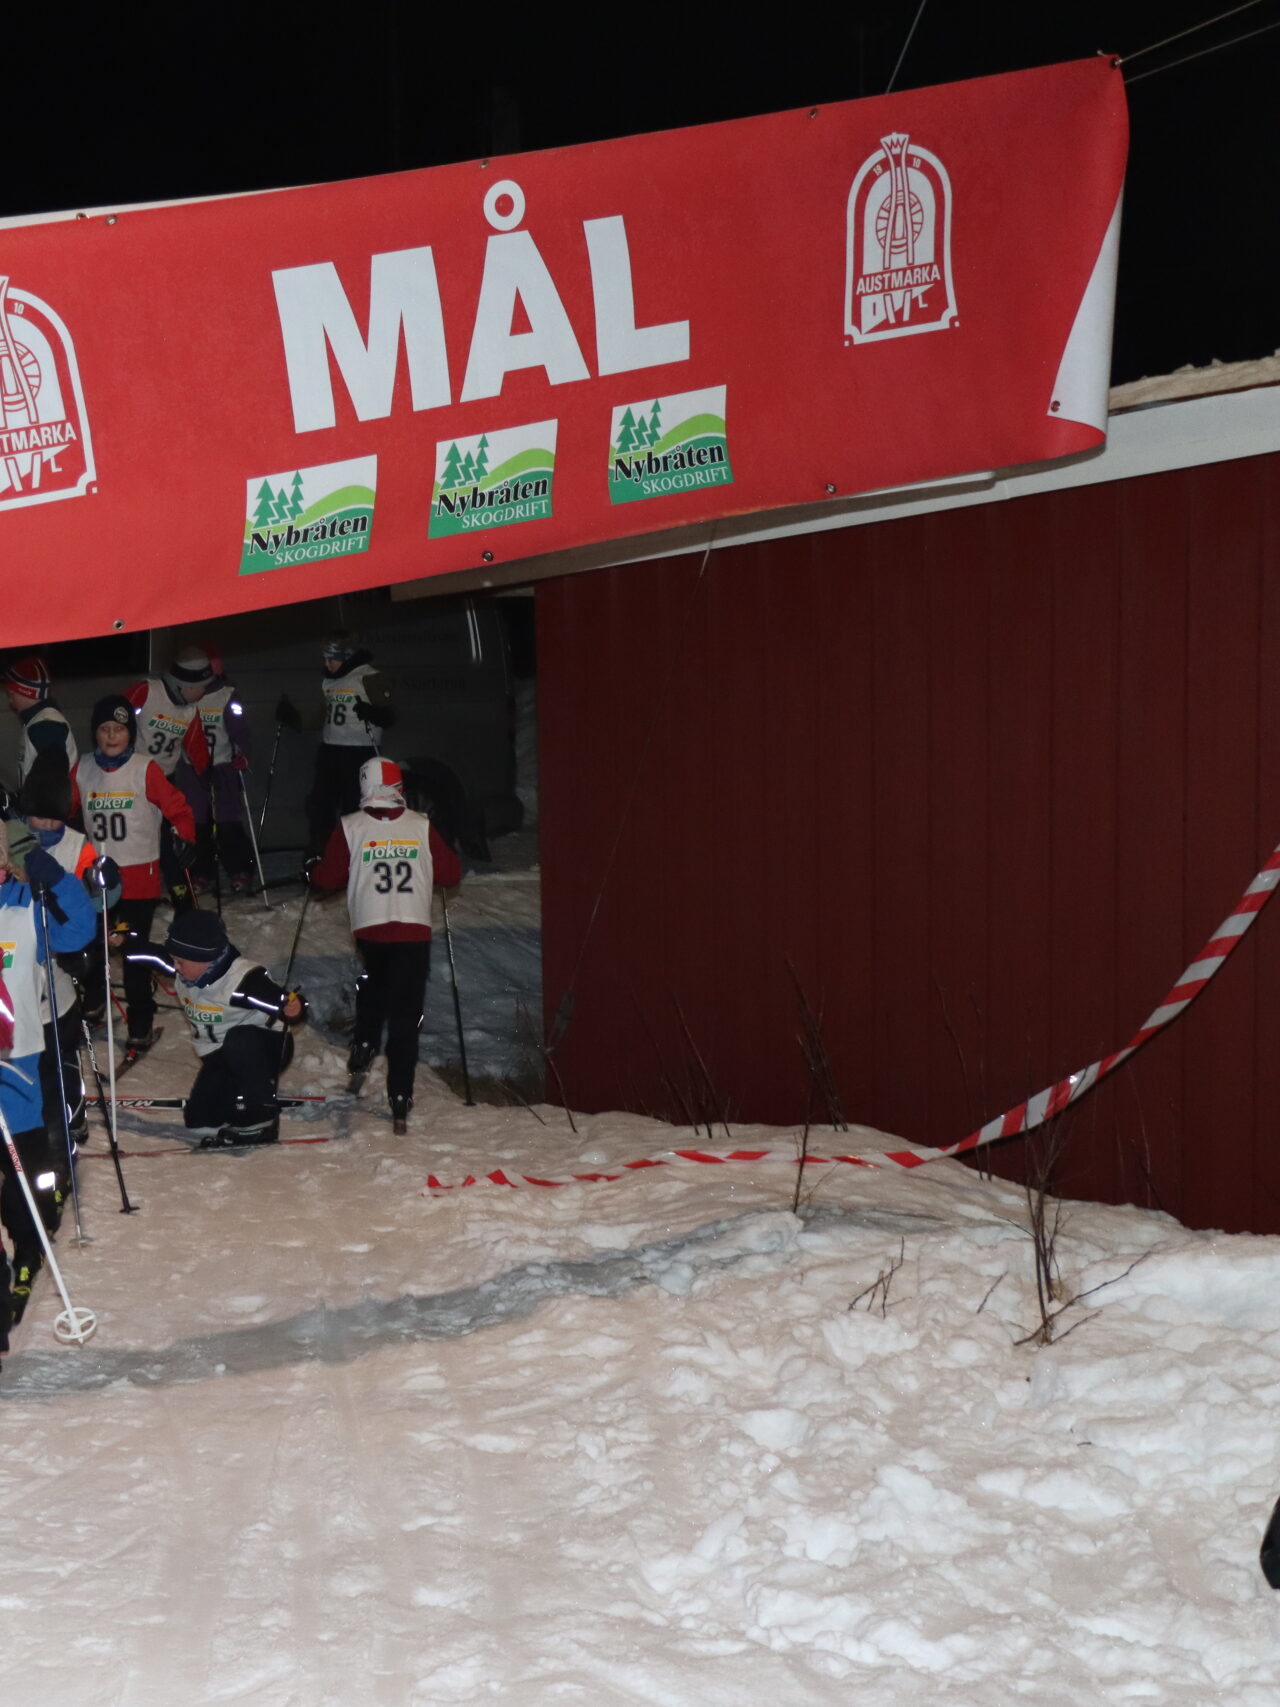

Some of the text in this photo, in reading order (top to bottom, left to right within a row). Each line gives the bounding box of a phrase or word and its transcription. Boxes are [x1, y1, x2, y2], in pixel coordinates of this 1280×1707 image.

[856, 264, 941, 295] AUSTMARKA
[13, 302, 25, 315] 10
[271, 179, 689, 434] MÅL
[613, 444, 725, 483] Nybråten
[642, 467, 728, 495] SKOGDRIFT
[435, 478, 548, 517] Nybråten
[462, 500, 548, 529] SKOGDRIFT
[249, 515, 368, 555] Nybråten
[274, 536, 367, 565] SKOGDRIFT
[148, 732, 177, 757] 34
[93, 812, 127, 842] 30
[364, 840, 414, 865] joker
[374, 861, 413, 894] 32
